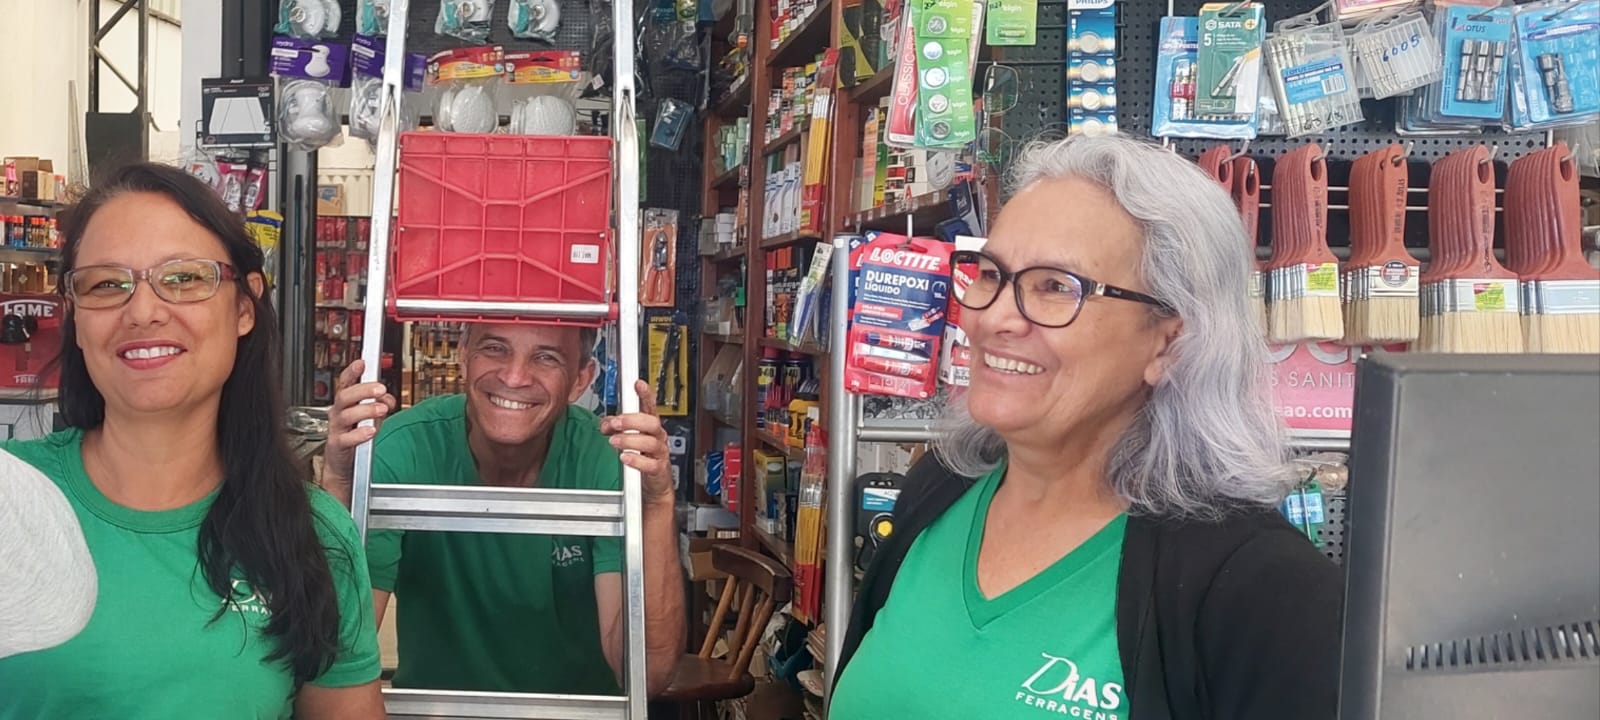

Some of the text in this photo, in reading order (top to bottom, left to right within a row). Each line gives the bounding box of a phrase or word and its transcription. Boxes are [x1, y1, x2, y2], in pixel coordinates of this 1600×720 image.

[1218, 20, 1242, 29] SATA
[1203, 33, 1212, 46] 5
[1382, 33, 1422, 62] 6005
[897, 54, 916, 106] CLASSIC
[869, 246, 941, 271] LOCTITE
[863, 281, 901, 296] LÍQUIDO
[865, 270, 930, 291] DUREPOXI
[1, 300, 56, 317] FAME
[1288, 371, 1355, 388] SANIT
